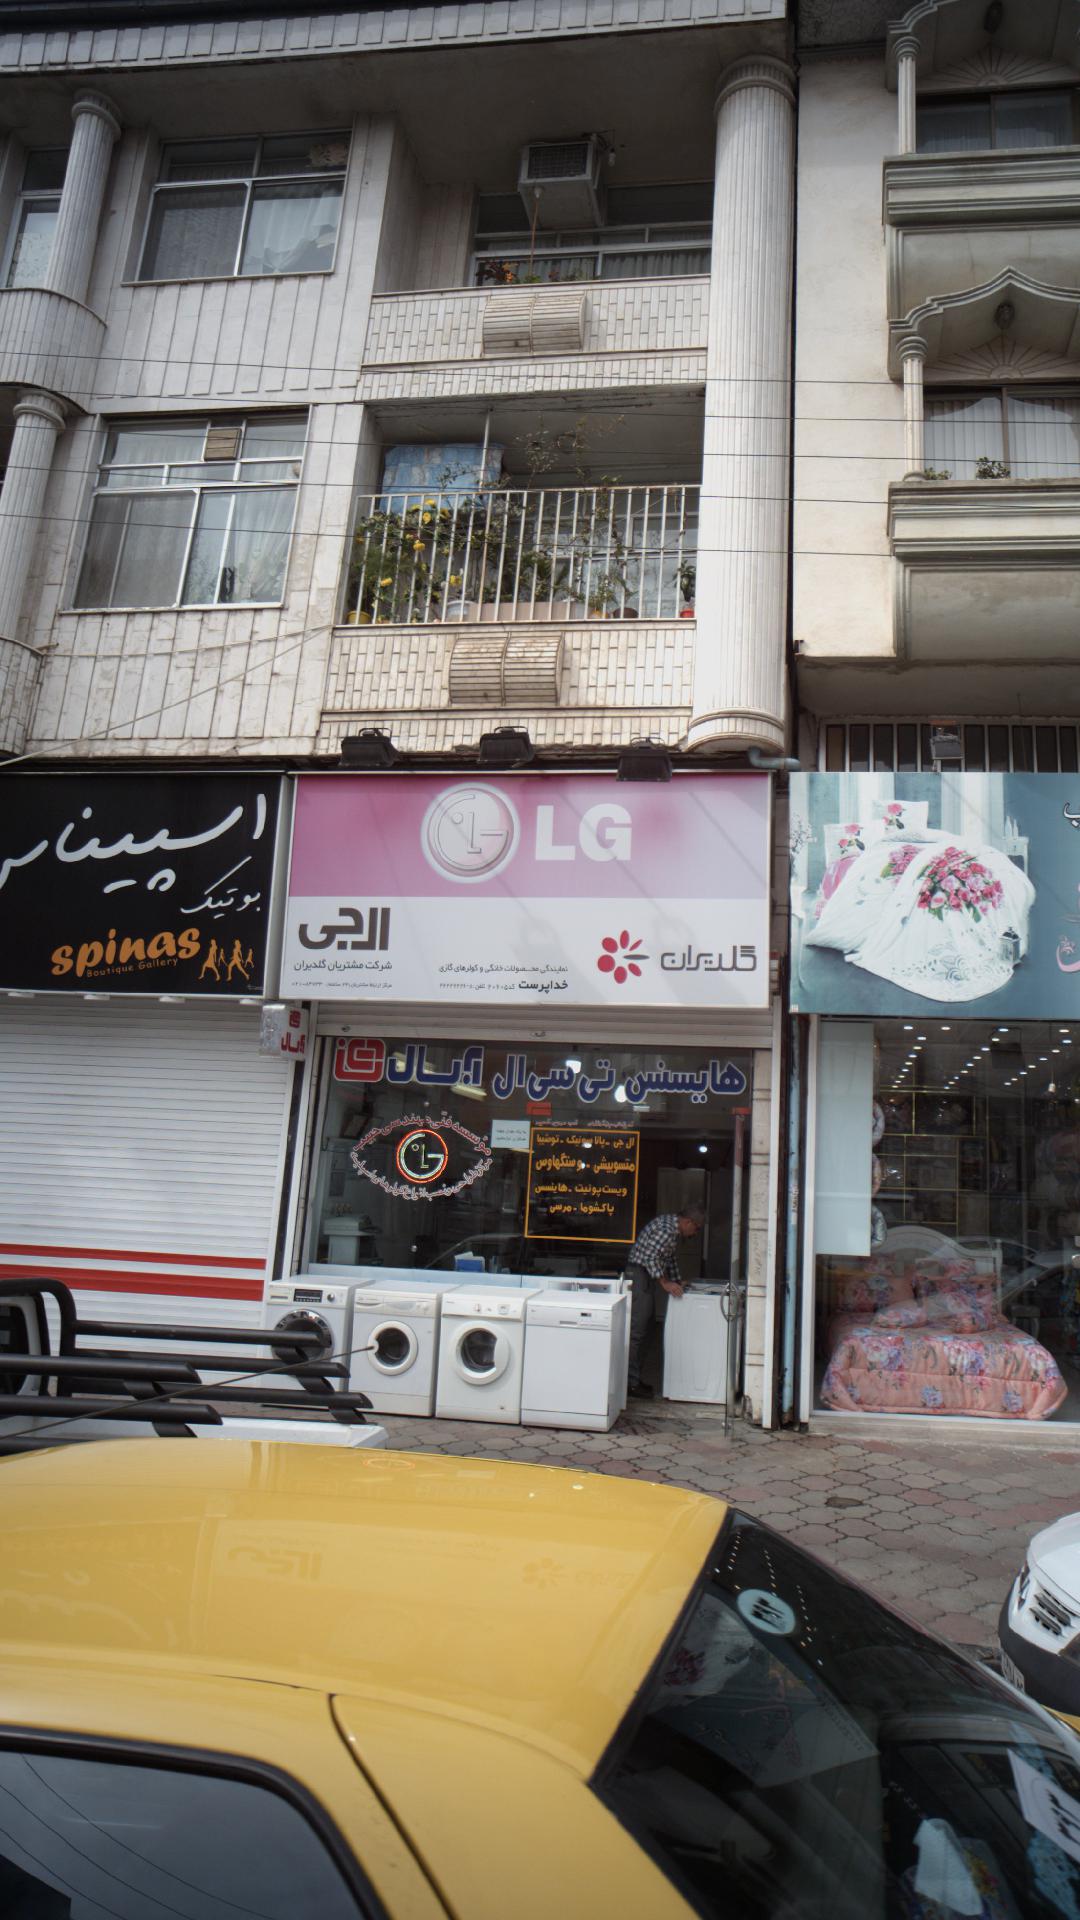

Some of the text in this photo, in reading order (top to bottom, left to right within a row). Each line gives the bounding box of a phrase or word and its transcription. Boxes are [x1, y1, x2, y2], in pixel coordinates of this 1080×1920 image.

[535, 803, 632, 862] LG
[180, 856, 261, 919] بوتیک
[51, 928, 201, 977] spinas
[660, 945, 757, 972] گلدیران
[87, 957, 179, 978] Boutique Gallery
[293, 959, 393, 972] شرکت مشتریان گلدیران
[438, 963, 453, 973] گازی
[453, 963, 478, 973] کولرهای
[484, 963, 503, 973] خانگی
[518, 979, 569, 994] خداپرست
[577, 1058, 616, 1103] تی
[624, 1059, 748, 1104] هایسنس
